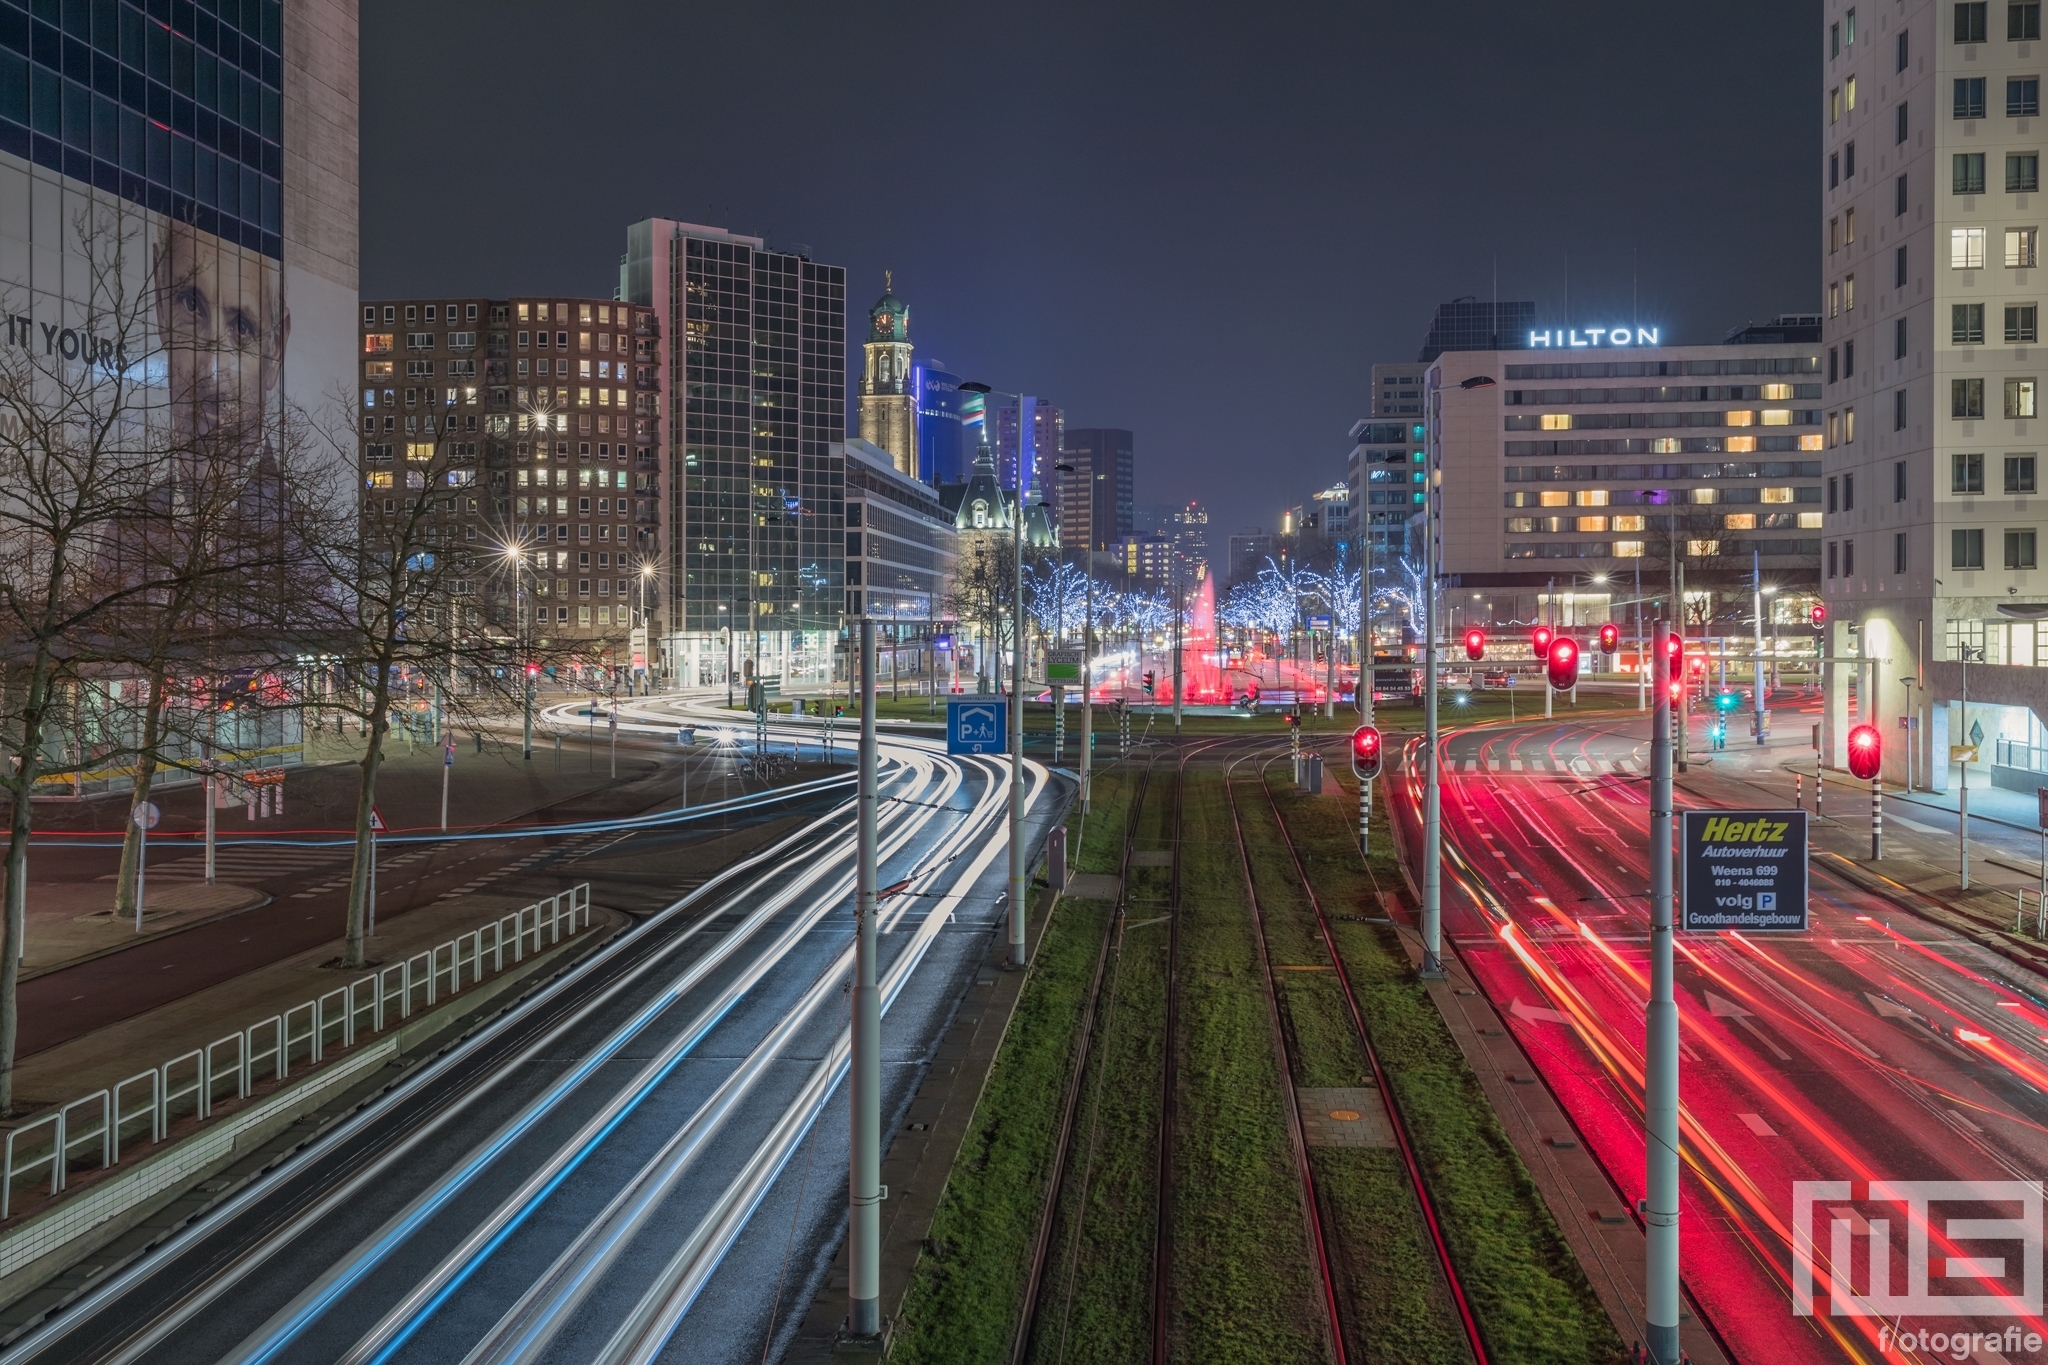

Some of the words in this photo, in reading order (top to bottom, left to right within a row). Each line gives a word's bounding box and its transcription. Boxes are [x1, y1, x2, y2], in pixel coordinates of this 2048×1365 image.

[8, 313, 32, 348] IT
[39, 321, 128, 375] YOURS
[1530, 327, 1658, 347] HILTON
[1701, 817, 1789, 842] Hertz
[1701, 845, 1789, 858] Autoverhuur
[1711, 865, 1753, 876] Weena
[1755, 866, 1778, 876] 699
[1714, 879, 1732, 887] 010
[1715, 894, 1753, 910] volg
[1689, 912, 1801, 927] Groothandelsgebouw
